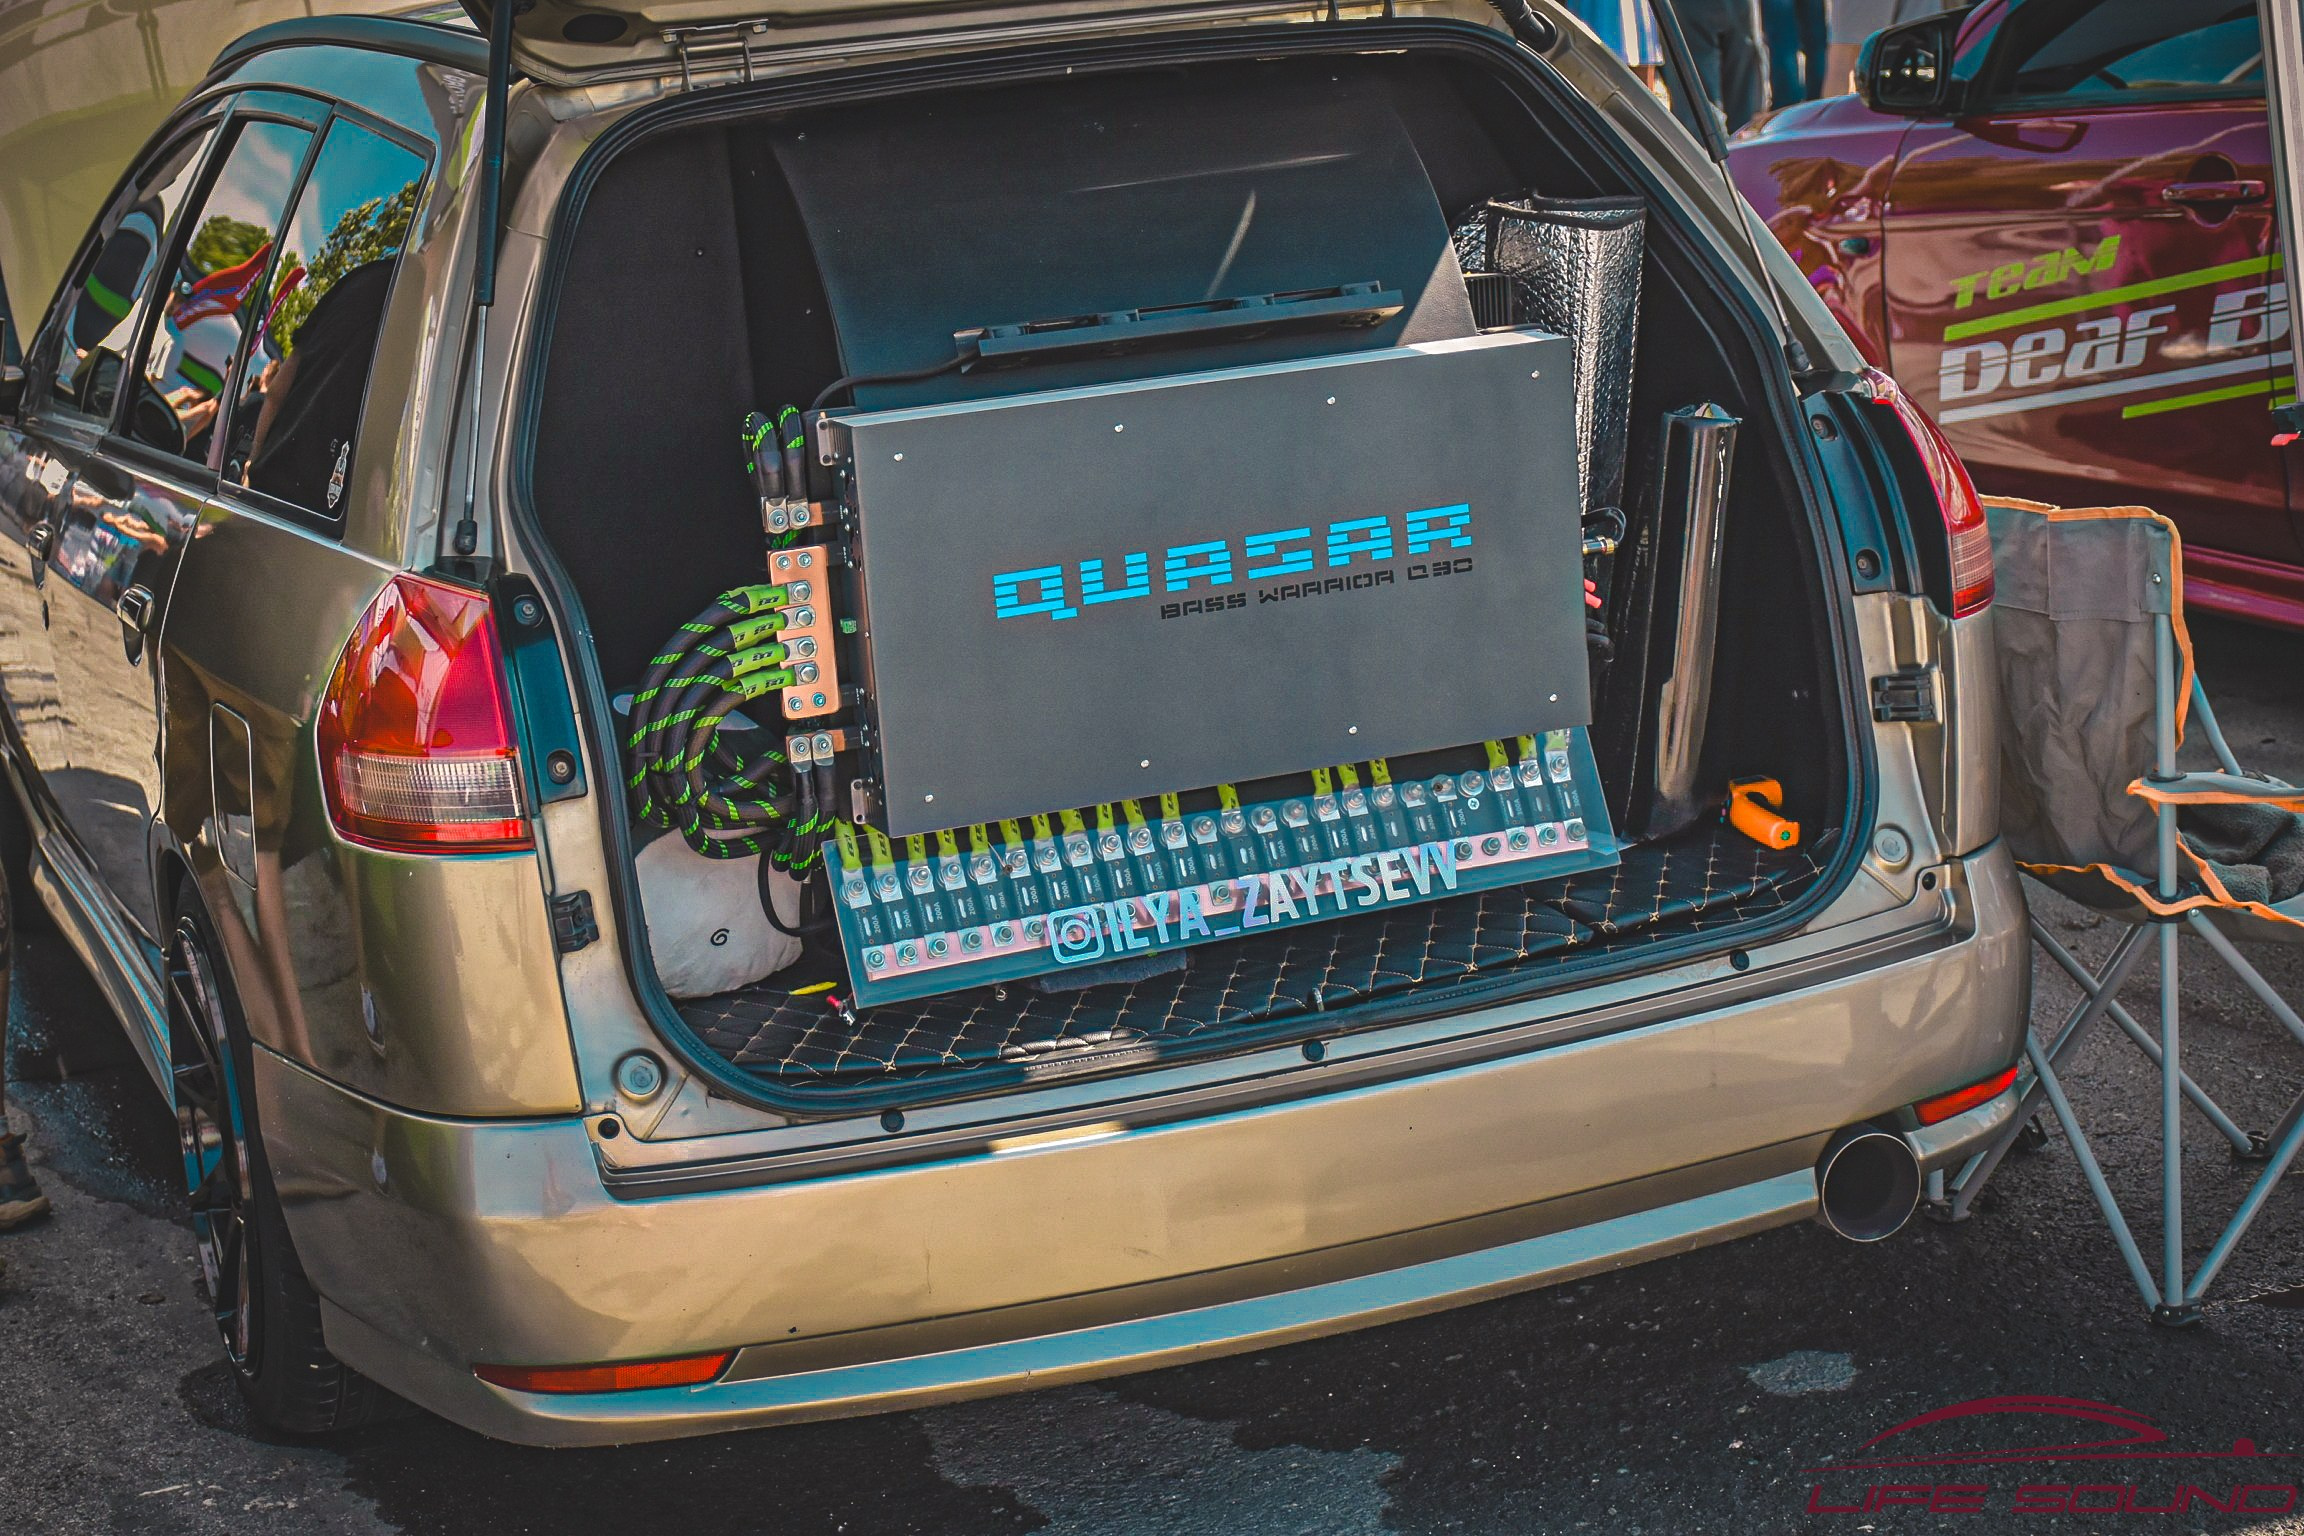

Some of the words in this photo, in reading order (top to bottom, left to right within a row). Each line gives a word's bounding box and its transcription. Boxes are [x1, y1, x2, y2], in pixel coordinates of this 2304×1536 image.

[993, 503, 1471, 620] QUASAR
[1160, 592, 1247, 620] BASS
[1258, 570, 1394, 604] WARRIOR
[1457, 808, 1466, 825] 200A
[1340, 828, 1349, 846] 200A
[1187, 856, 1196, 875] 200A
[1124, 868, 1133, 886] 200A
[1029, 885, 1039, 903] 200A
[1061, 880, 1070, 898] 200A
[934, 902, 942, 920] 200A
[966, 897, 976, 915] 200A
[872, 915, 881, 933] 200A
[902, 909, 911, 928] 200A
